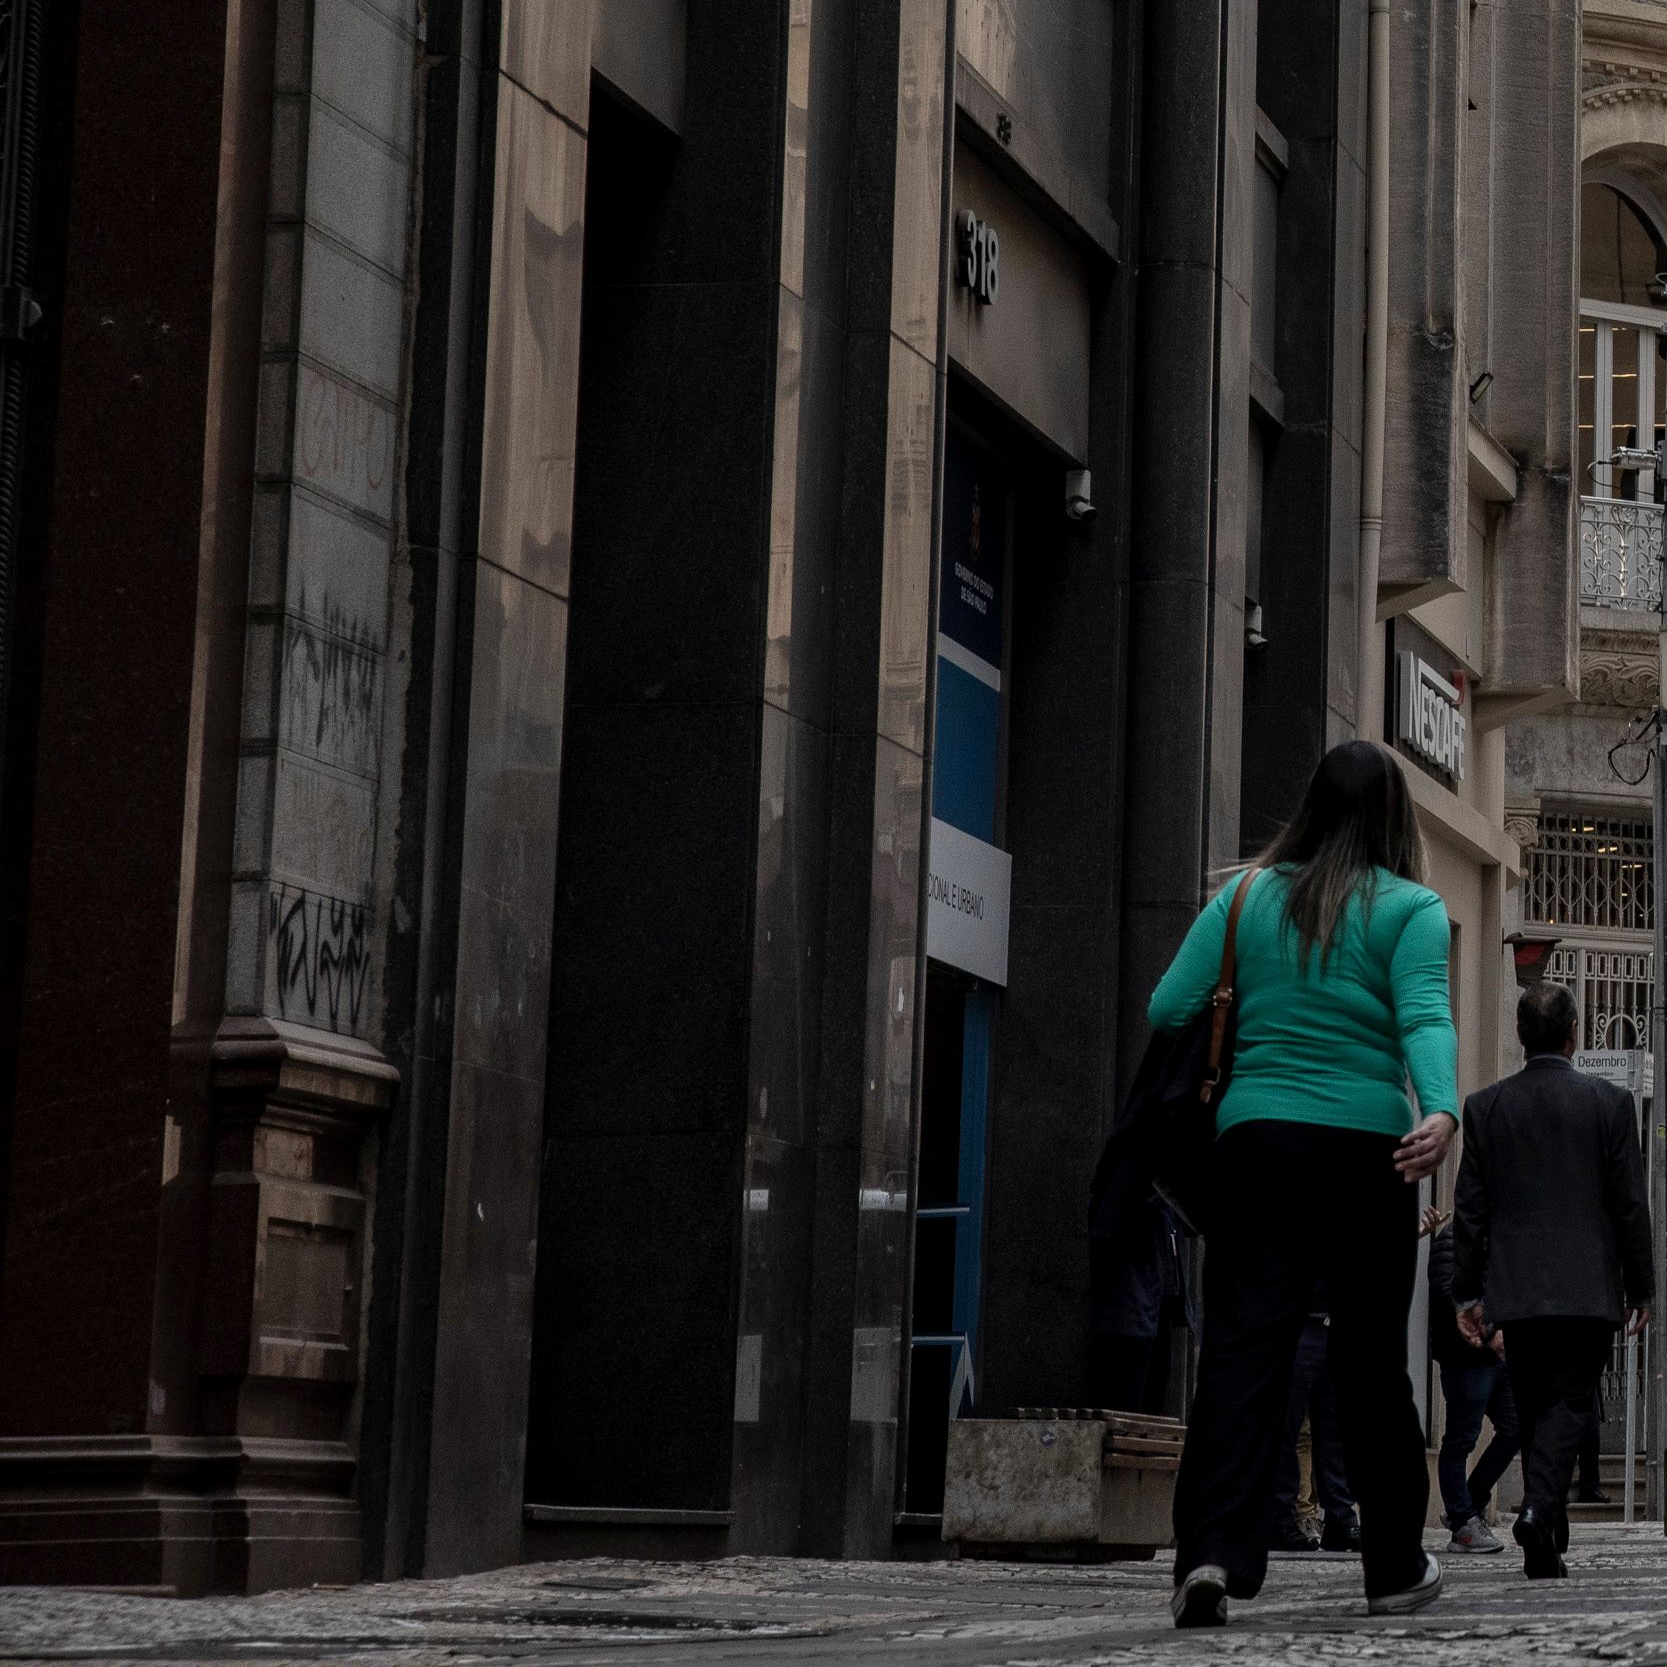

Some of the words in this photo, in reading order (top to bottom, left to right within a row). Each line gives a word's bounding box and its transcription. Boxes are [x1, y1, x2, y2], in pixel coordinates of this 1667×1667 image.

[960, 209, 999, 305] 318
[952, 883, 957, 909] E
[957, 886, 985, 920] URBANO
[1578, 1056, 1627, 1068] Dezembro
